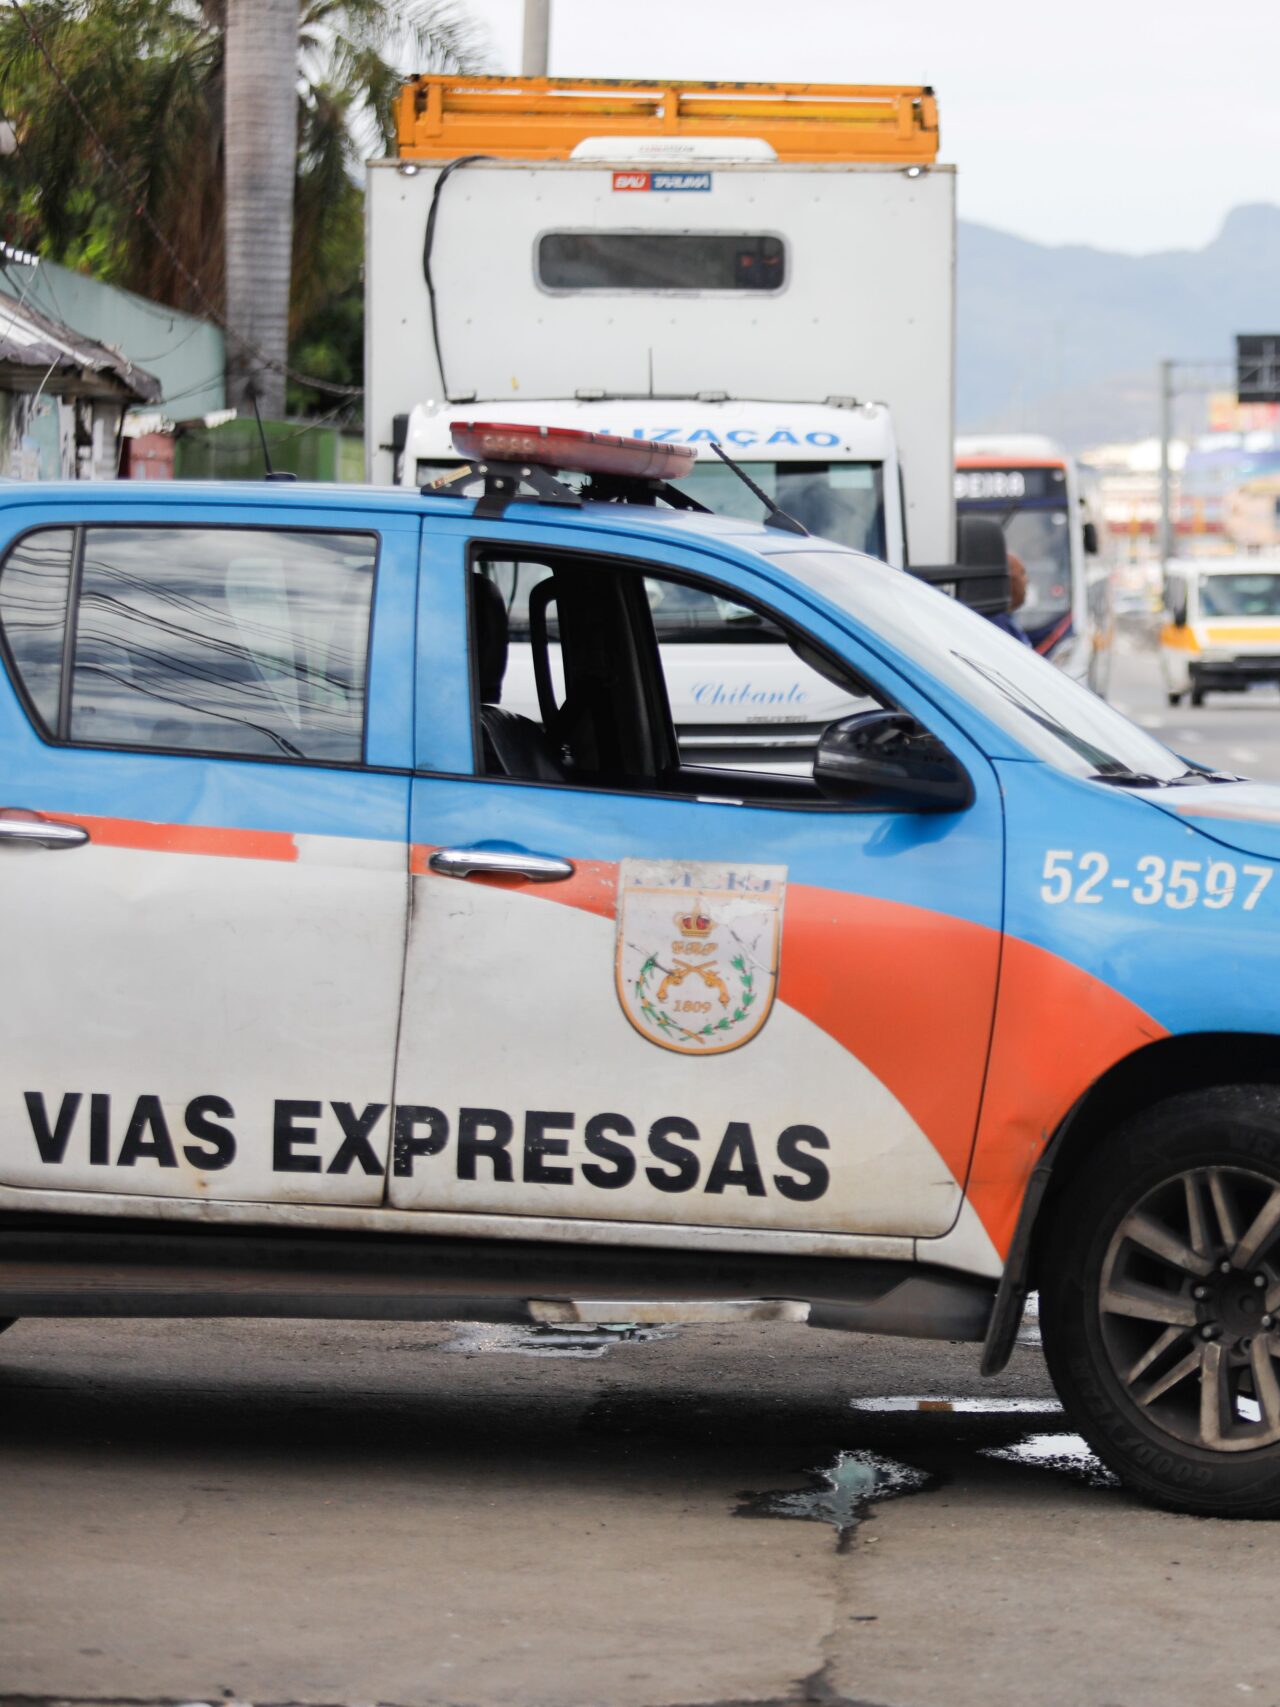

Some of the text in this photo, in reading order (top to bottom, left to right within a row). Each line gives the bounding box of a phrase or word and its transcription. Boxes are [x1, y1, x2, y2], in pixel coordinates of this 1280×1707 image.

[1041, 850, 1274, 910] 52-3597
[672, 1000, 712, 1013] 1809
[24, 1092, 829, 1202] VIAS EXPRESSAS
